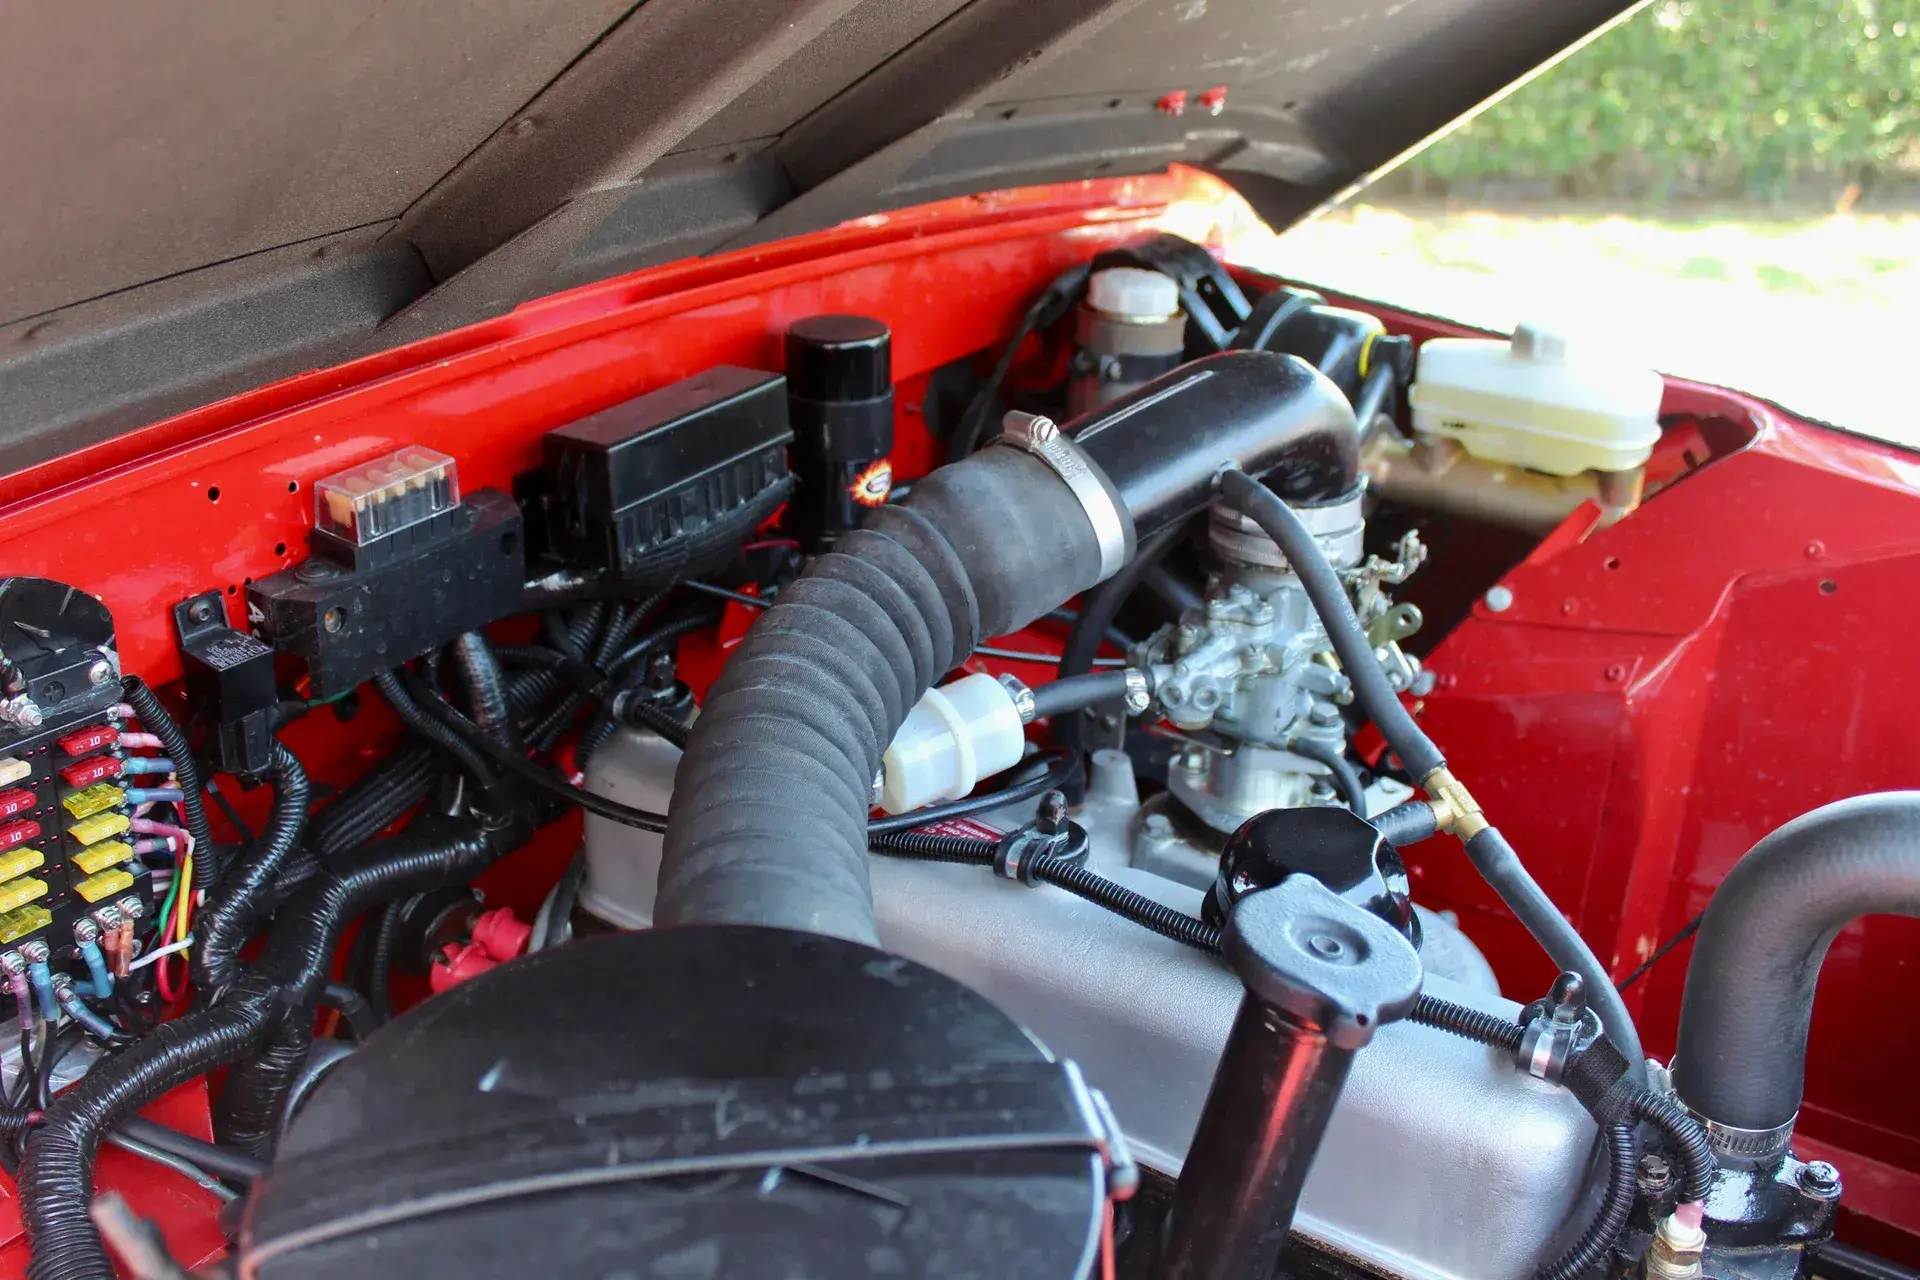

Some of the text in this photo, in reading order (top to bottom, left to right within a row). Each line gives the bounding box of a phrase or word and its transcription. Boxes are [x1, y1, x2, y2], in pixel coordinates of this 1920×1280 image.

[248, 601, 265, 623] 4
[89, 735, 101, 747] 10
[93, 767, 104, 778] 10
[5, 802, 18, 814] 10
[9, 831, 22, 843] 10
[956, 824, 991, 840] ENGINE
[104, 854, 115, 866] 20
[13, 862, 26, 873] 20
[106, 882, 118, 894] 20
[18, 892, 30, 903] 20
